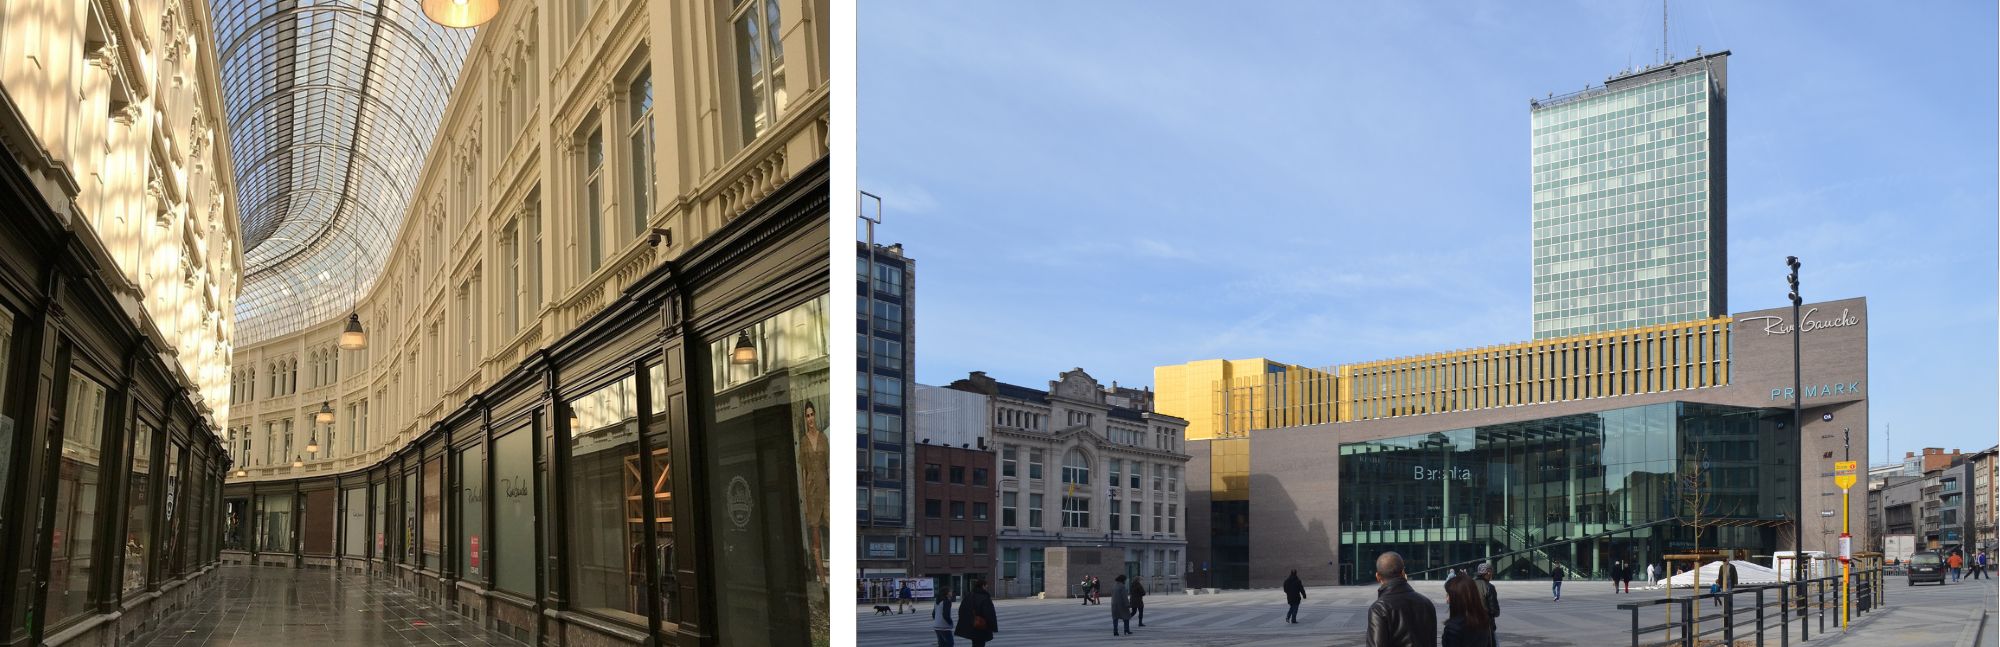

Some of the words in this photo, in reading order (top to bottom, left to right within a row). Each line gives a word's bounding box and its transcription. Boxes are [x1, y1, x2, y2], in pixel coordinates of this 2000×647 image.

[1740, 315, 1796, 336] Riv
[1800, 307, 1859, 332] Gauche
[1771, 381, 1860, 401] PRMARK
